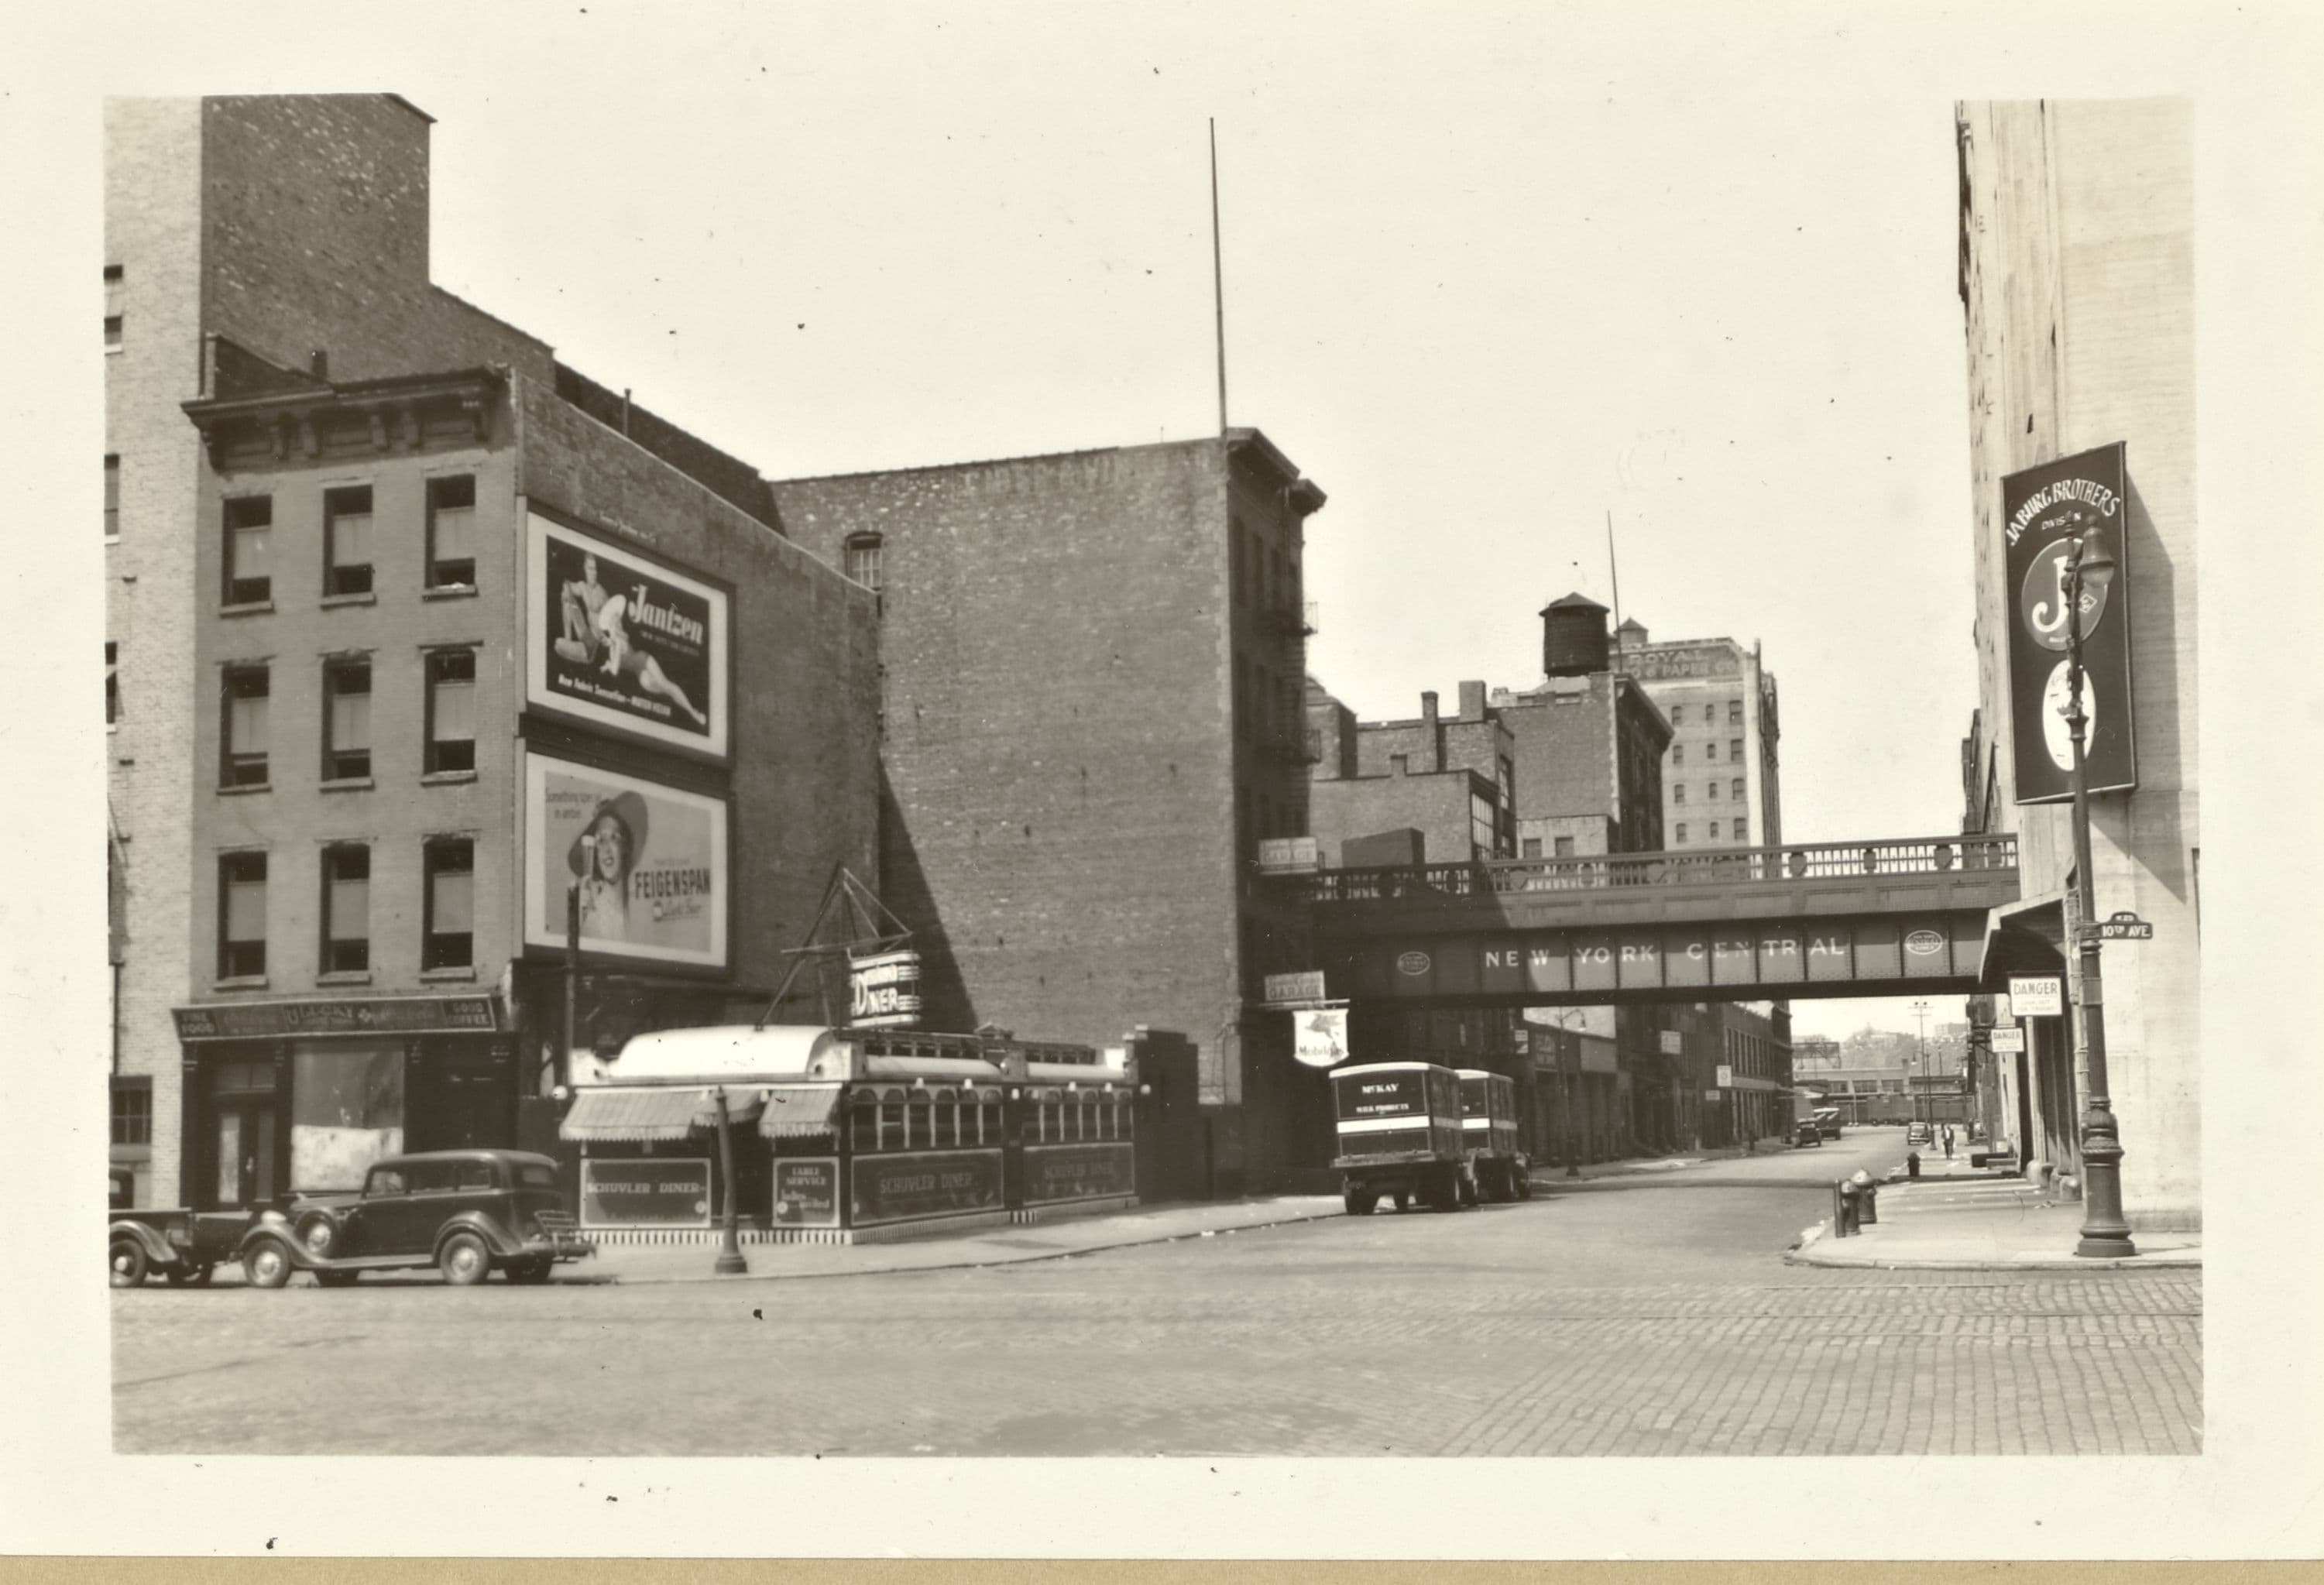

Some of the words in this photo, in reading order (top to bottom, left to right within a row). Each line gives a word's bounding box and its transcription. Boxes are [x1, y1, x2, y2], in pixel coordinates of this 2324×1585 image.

[2006, 486, 2052, 547] JABURG
[2052, 478, 2121, 517] BROTHERS
[629, 584, 703, 645] Jantzen
[1629, 650, 1708, 665] ROYAL
[1662, 662, 1709, 677] PAPER
[635, 868, 710, 899] FEIGENSPAN
[1485, 949, 1550, 967] NEW
[1576, 944, 1655, 964] YORK
[1686, 937, 1845, 960] CENTRAL
[1269, 985, 1320, 999] GARAGE
[2013, 983, 2058, 995] DANGER
